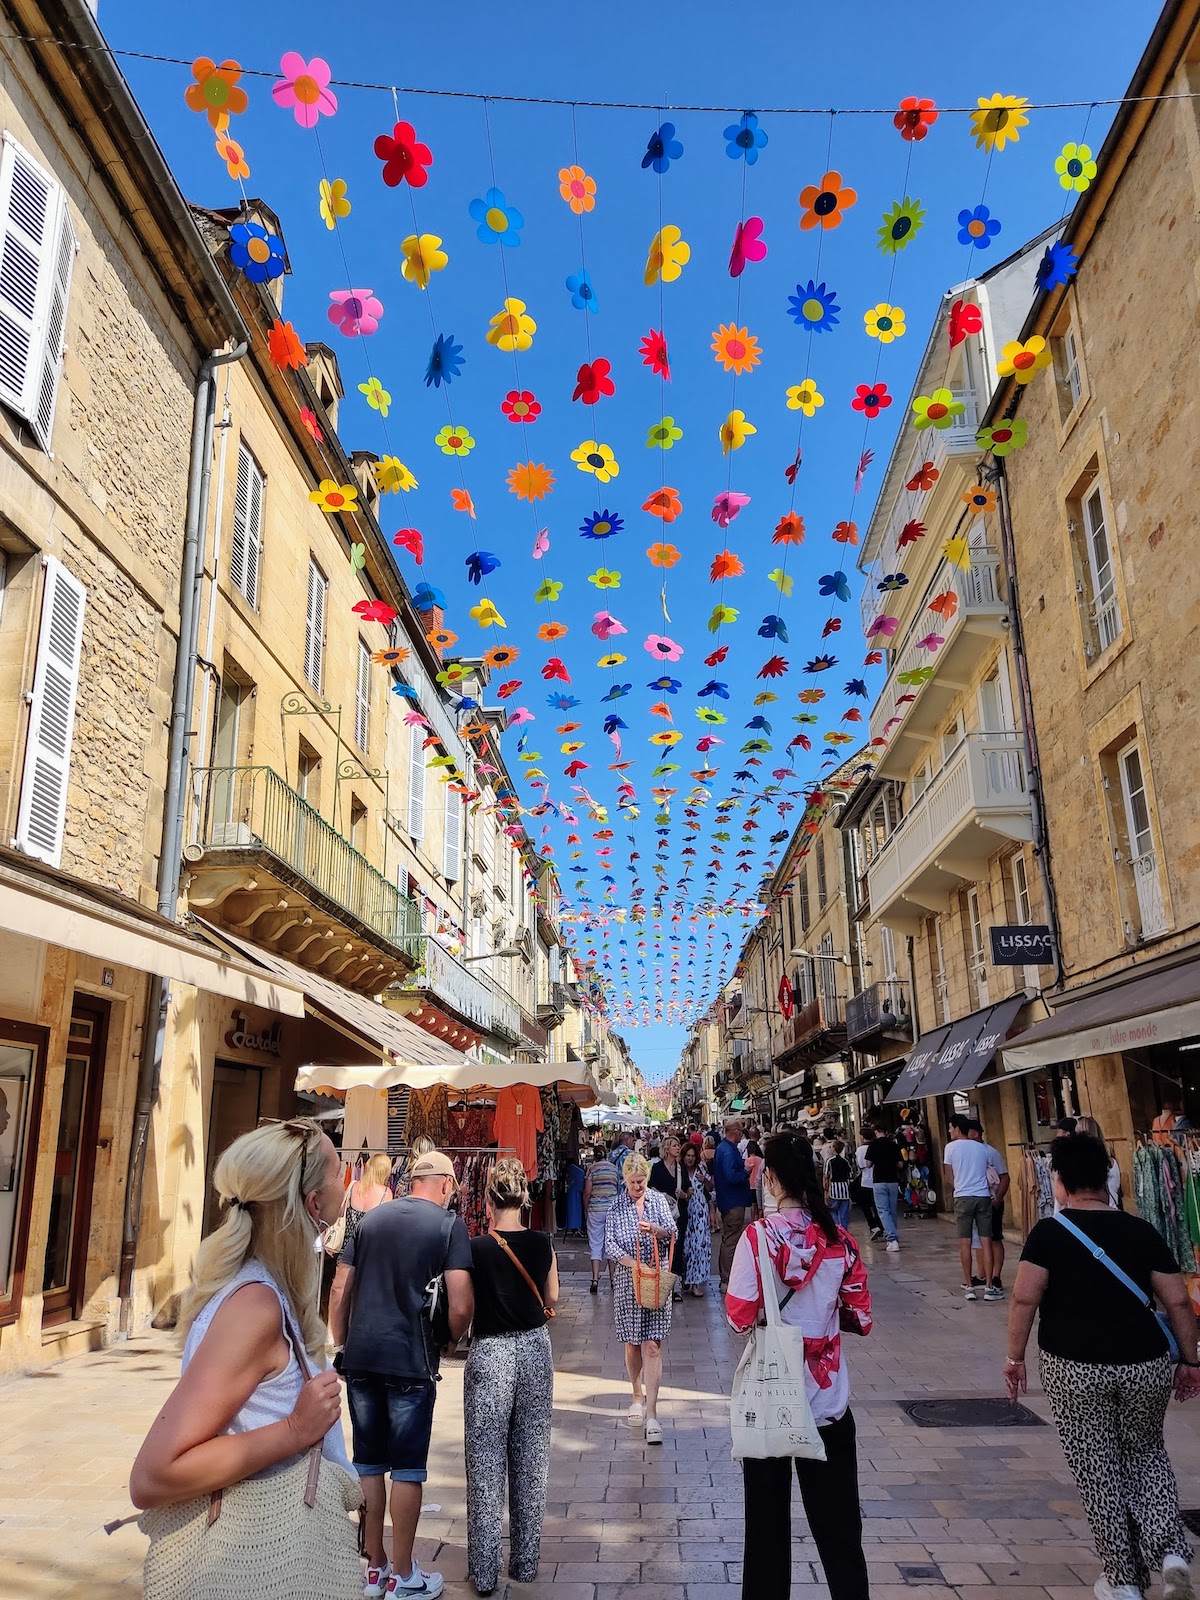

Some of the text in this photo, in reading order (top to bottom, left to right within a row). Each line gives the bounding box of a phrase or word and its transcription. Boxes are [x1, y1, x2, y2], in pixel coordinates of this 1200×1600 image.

[1001, 934, 1053, 948] LISSAC
[1129, 1021, 1158, 1042] monde
[938, 1038, 970, 1066] LISSAC
[974, 1032, 1001, 1054] LISSAC
[906, 1051, 933, 1073] LISSAC
